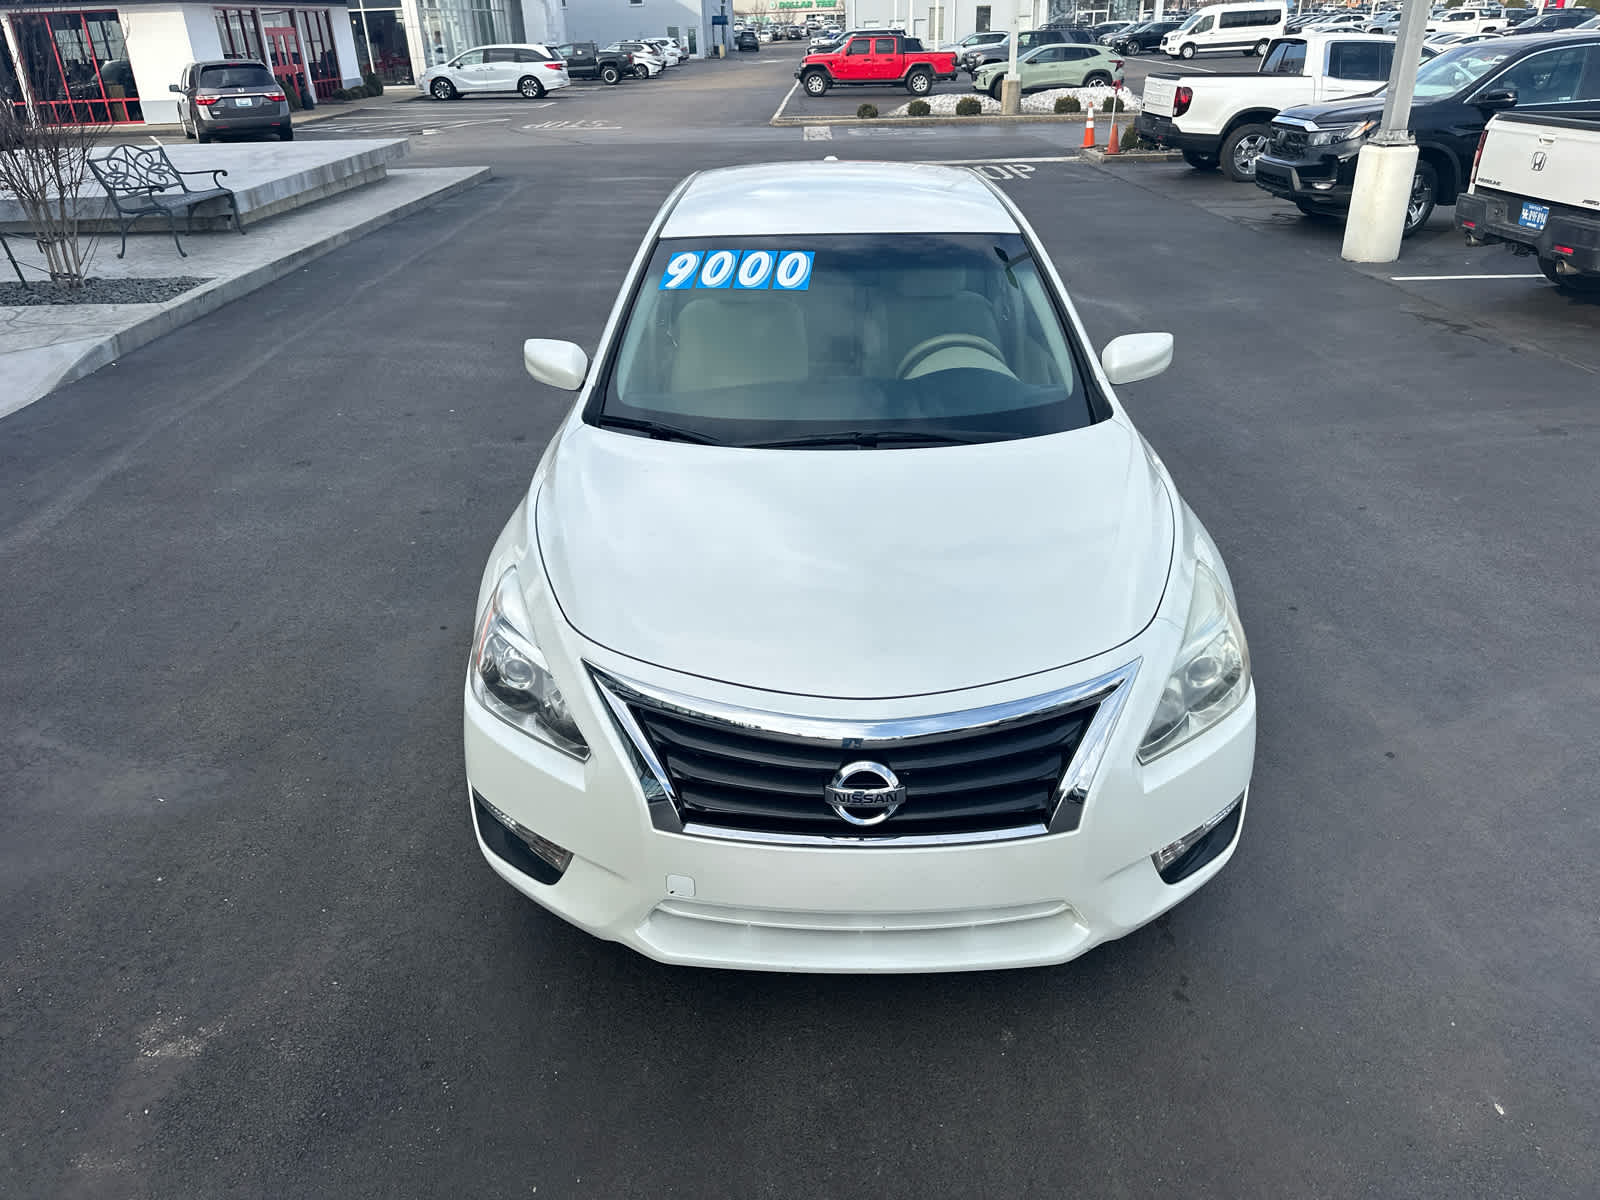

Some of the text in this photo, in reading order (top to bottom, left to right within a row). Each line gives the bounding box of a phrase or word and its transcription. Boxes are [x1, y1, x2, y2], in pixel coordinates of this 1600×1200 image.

[972, 164, 1036, 180] OP
[664, 250, 811, 289] 9000
[834, 793, 898, 804] NISSAN
